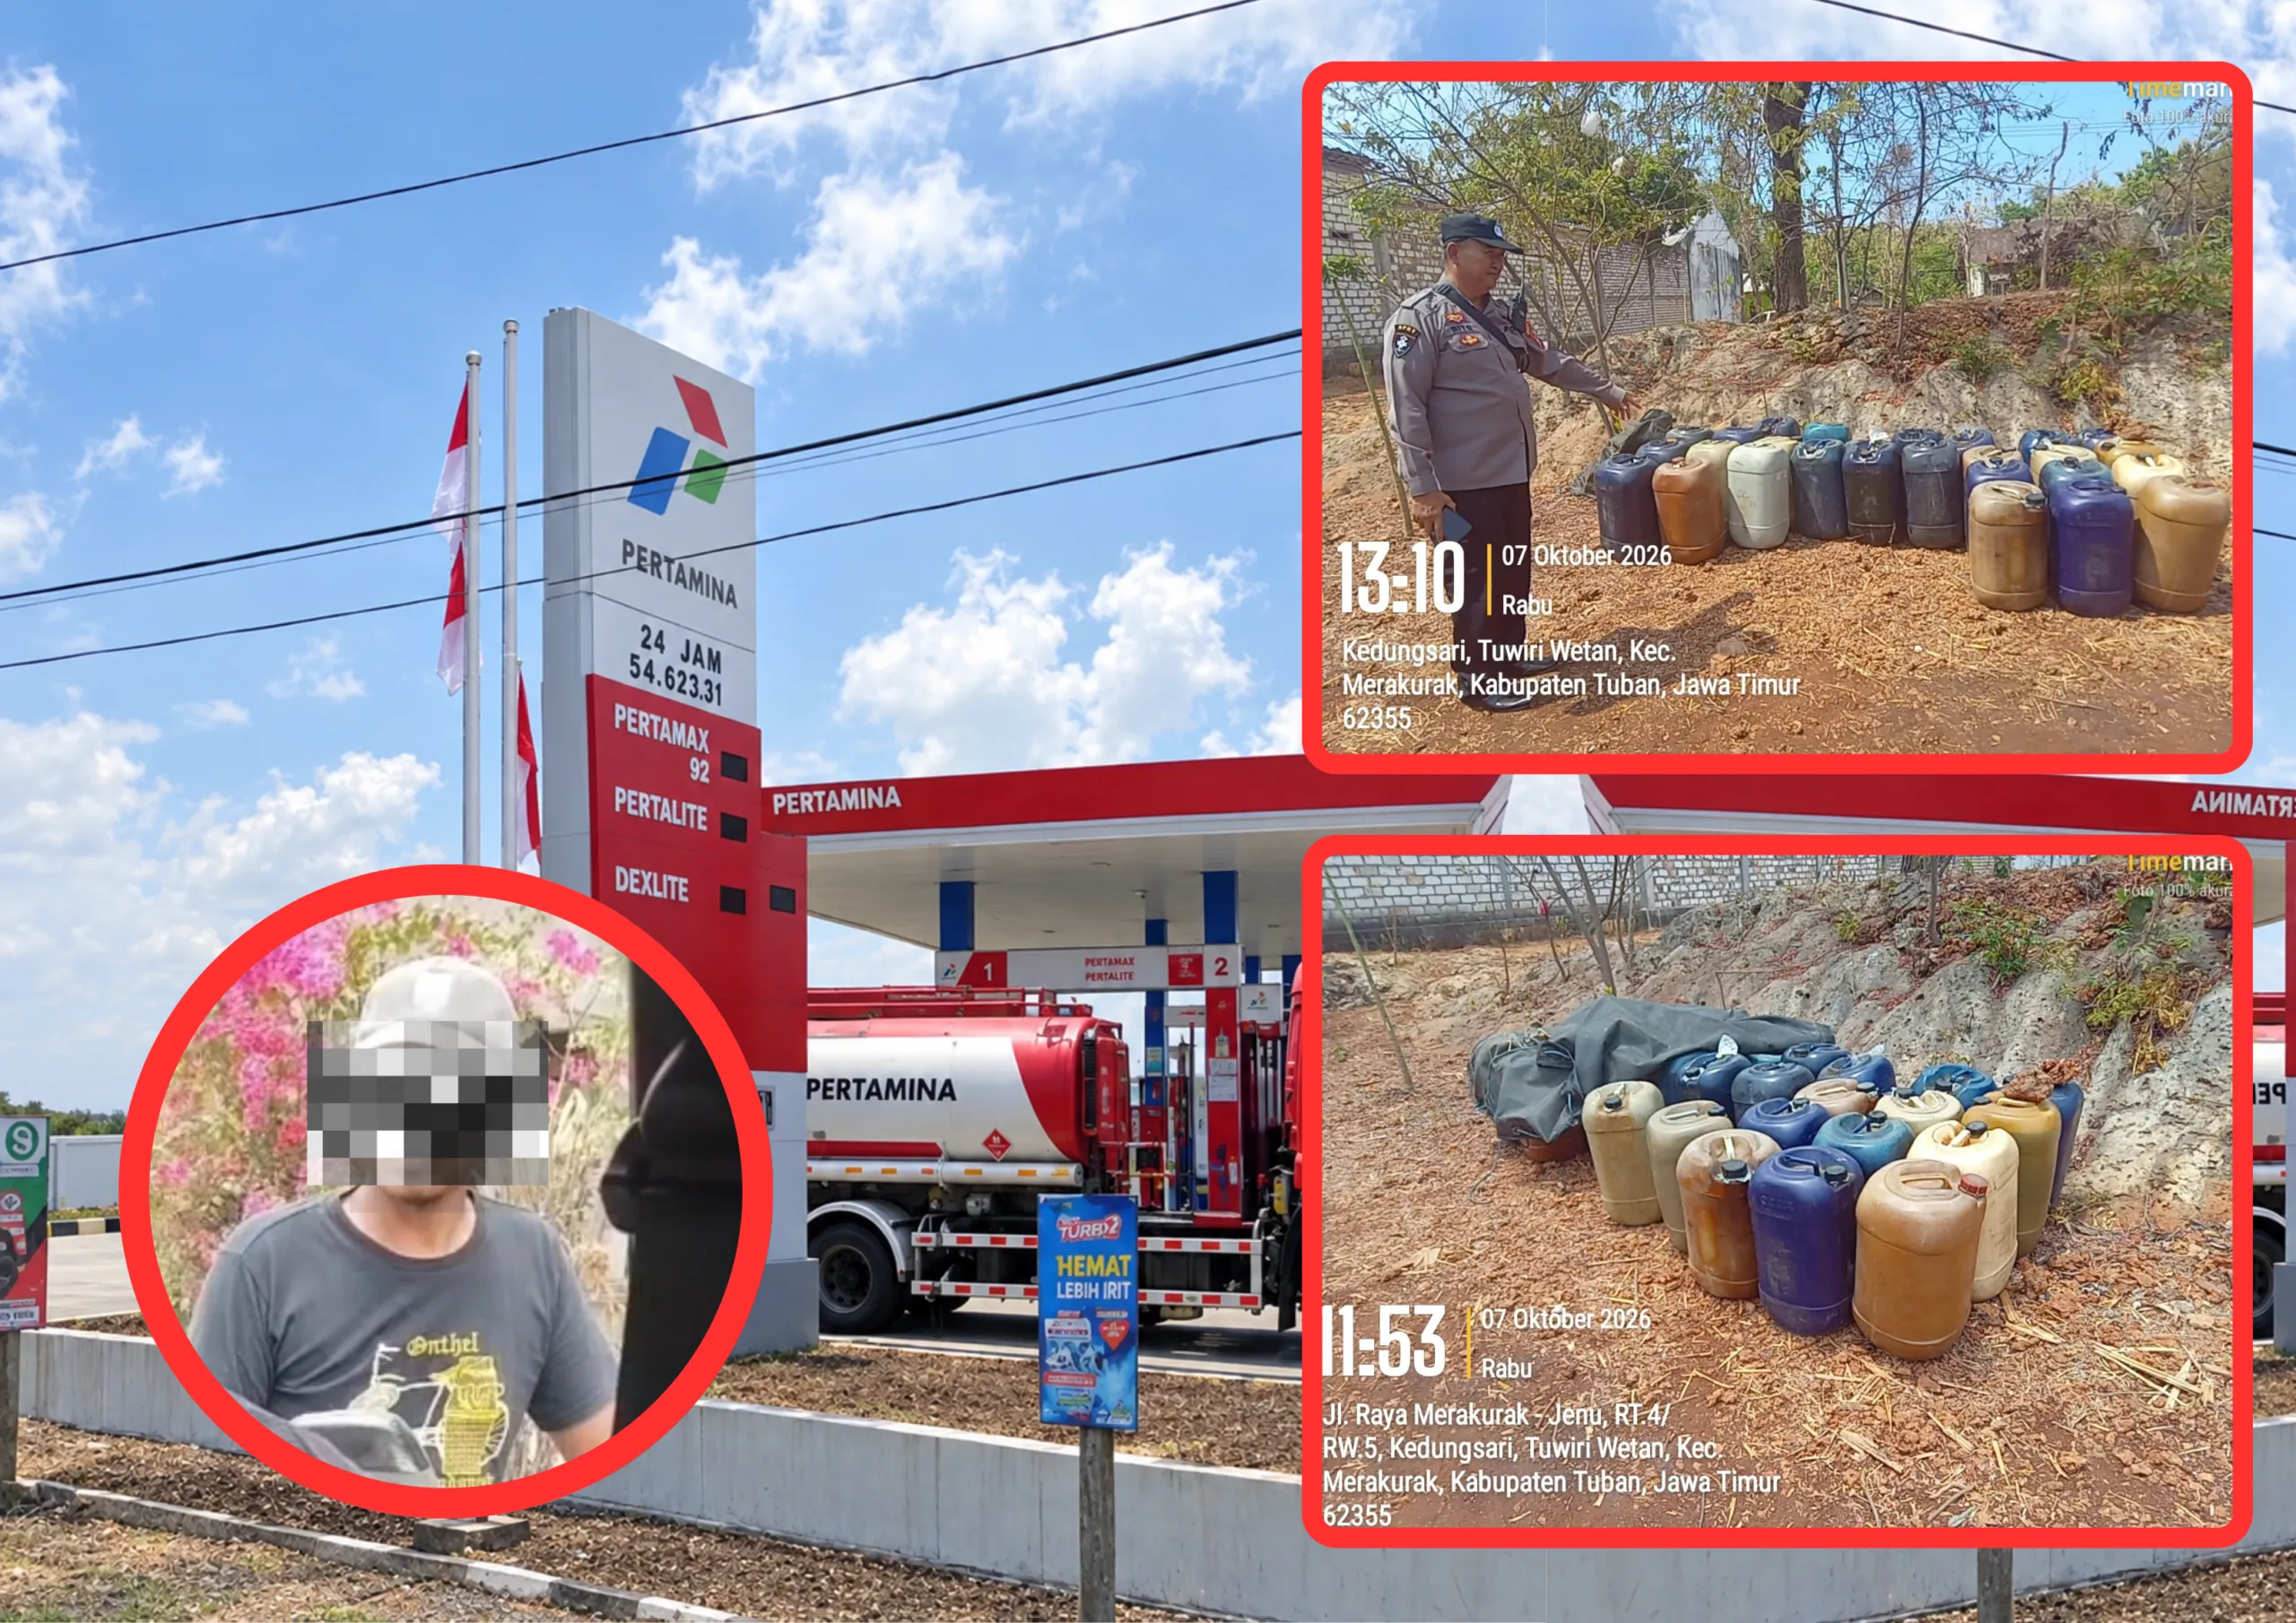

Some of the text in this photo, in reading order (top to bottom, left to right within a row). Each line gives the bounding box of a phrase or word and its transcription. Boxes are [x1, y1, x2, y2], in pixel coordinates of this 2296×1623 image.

[622, 538, 738, 610] PERTAMINA
[640, 623, 722, 674] 24 JAM
[630, 654, 722, 706] 54.623.31
[614, 702, 710, 754] PERTAMAX
[689, 757, 710, 785] 92
[614, 785, 708, 831] PERTALITE
[772, 785, 902, 815] PERTAMINA
[615, 865, 690, 902] DEXLITE
[983, 962, 993, 982] 1
[1084, 956, 1135, 968] PERTAMAX
[1213, 957, 1229, 976] 2
[1085, 971, 1135, 982] PERTALITE
[806, 1078, 958, 1101] PERTAMINA
[1056, 1254, 1131, 1277] HEMAT
[1057, 1281, 1131, 1300] LEBIH IRIT
[406, 1332, 480, 1358] Onthel
